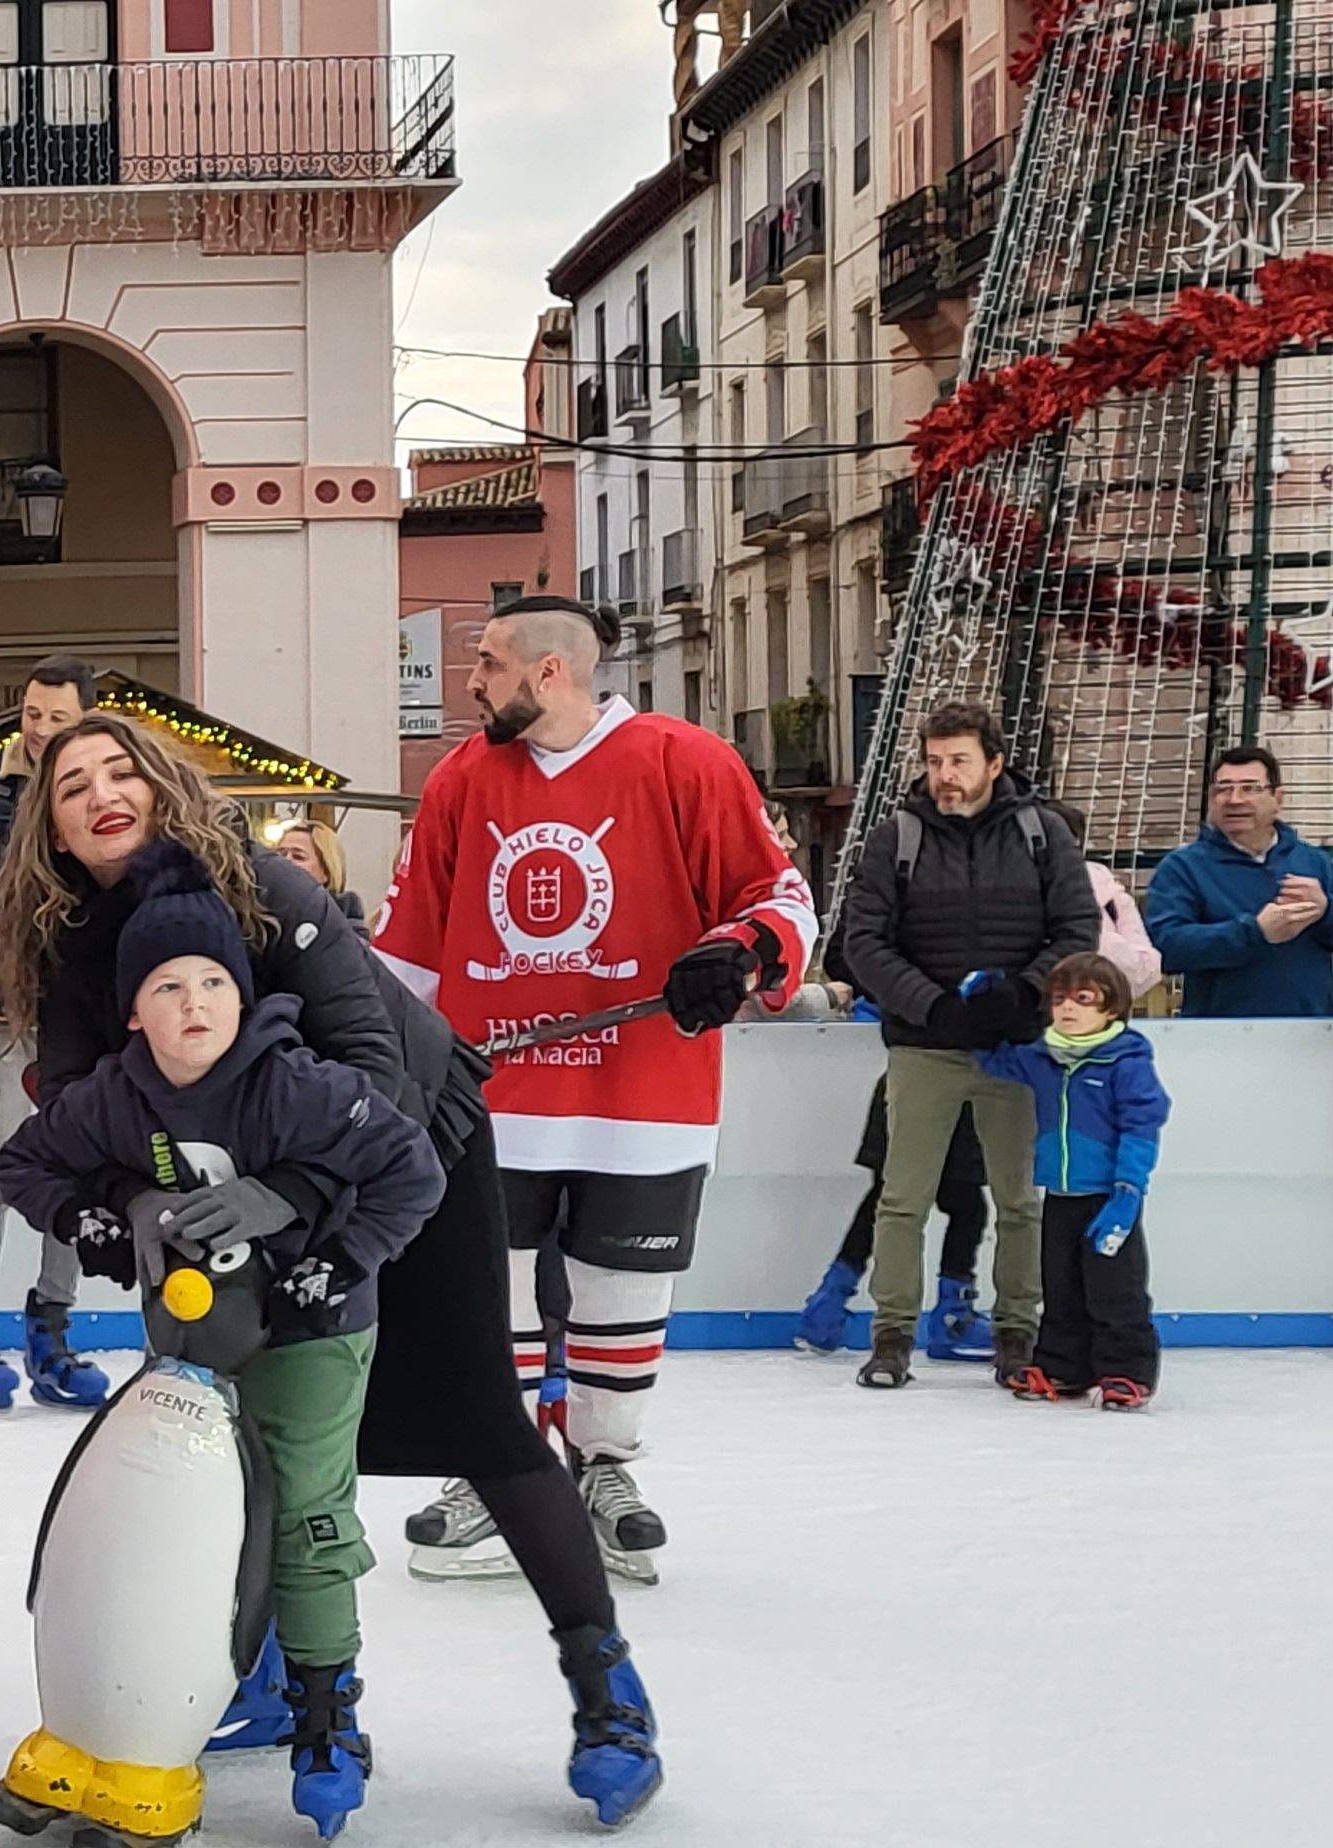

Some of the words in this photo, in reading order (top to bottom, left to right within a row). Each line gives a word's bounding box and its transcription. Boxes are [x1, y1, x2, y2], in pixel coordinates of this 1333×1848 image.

[508, 828, 584, 856] HIELO
[494, 862, 509, 933] CLUB
[583, 864, 608, 931] JACA
[500, 950, 603, 975] HOCKEY
[140, 1388, 208, 1422] VICENTE
